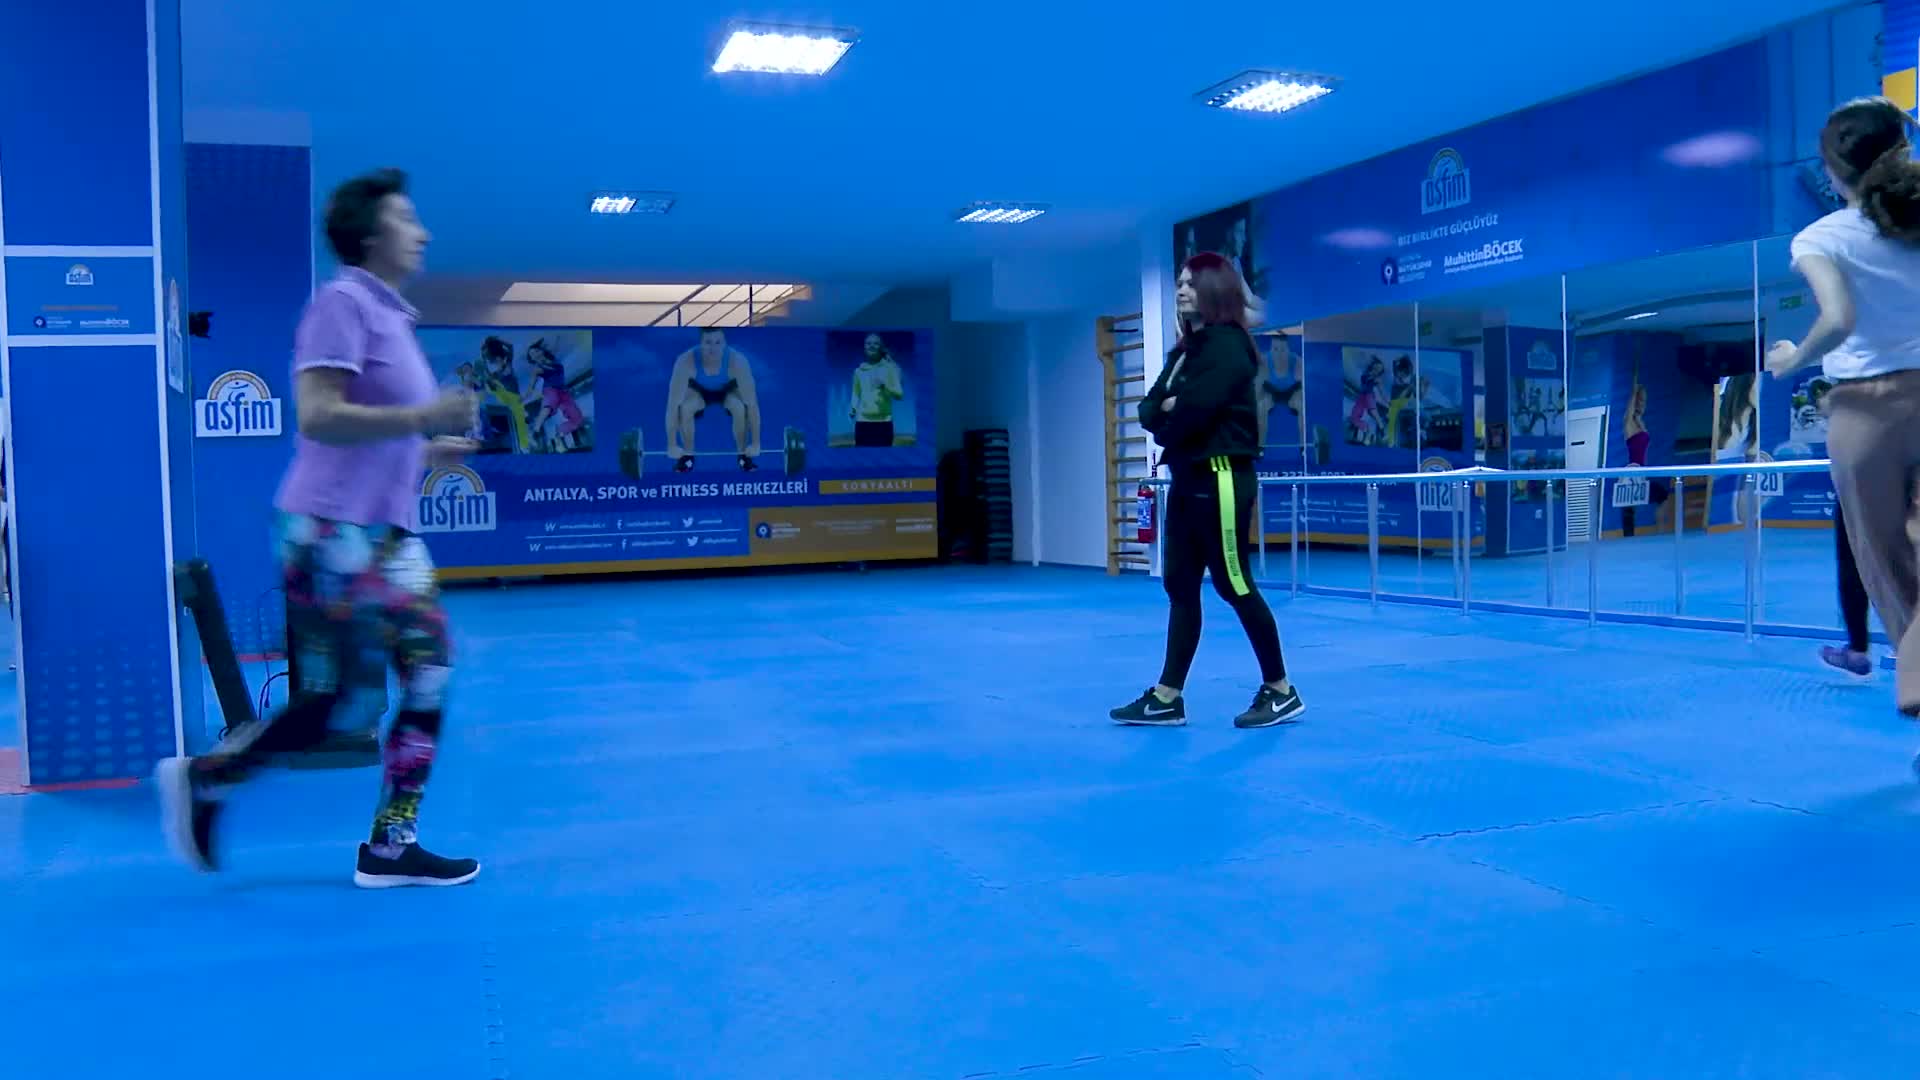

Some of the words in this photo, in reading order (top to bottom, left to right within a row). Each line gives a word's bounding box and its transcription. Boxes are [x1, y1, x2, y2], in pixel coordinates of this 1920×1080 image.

[1450, 213, 1499, 236] GÜÇLÜYÜZ
[205, 392, 275, 435] asfim
[524, 487, 593, 502] ANTALYA,
[597, 486, 638, 500] SPOR
[641, 487, 658, 498] ve
[723, 477, 809, 497] MERKEZLERİ
[419, 485, 489, 531] asfim
